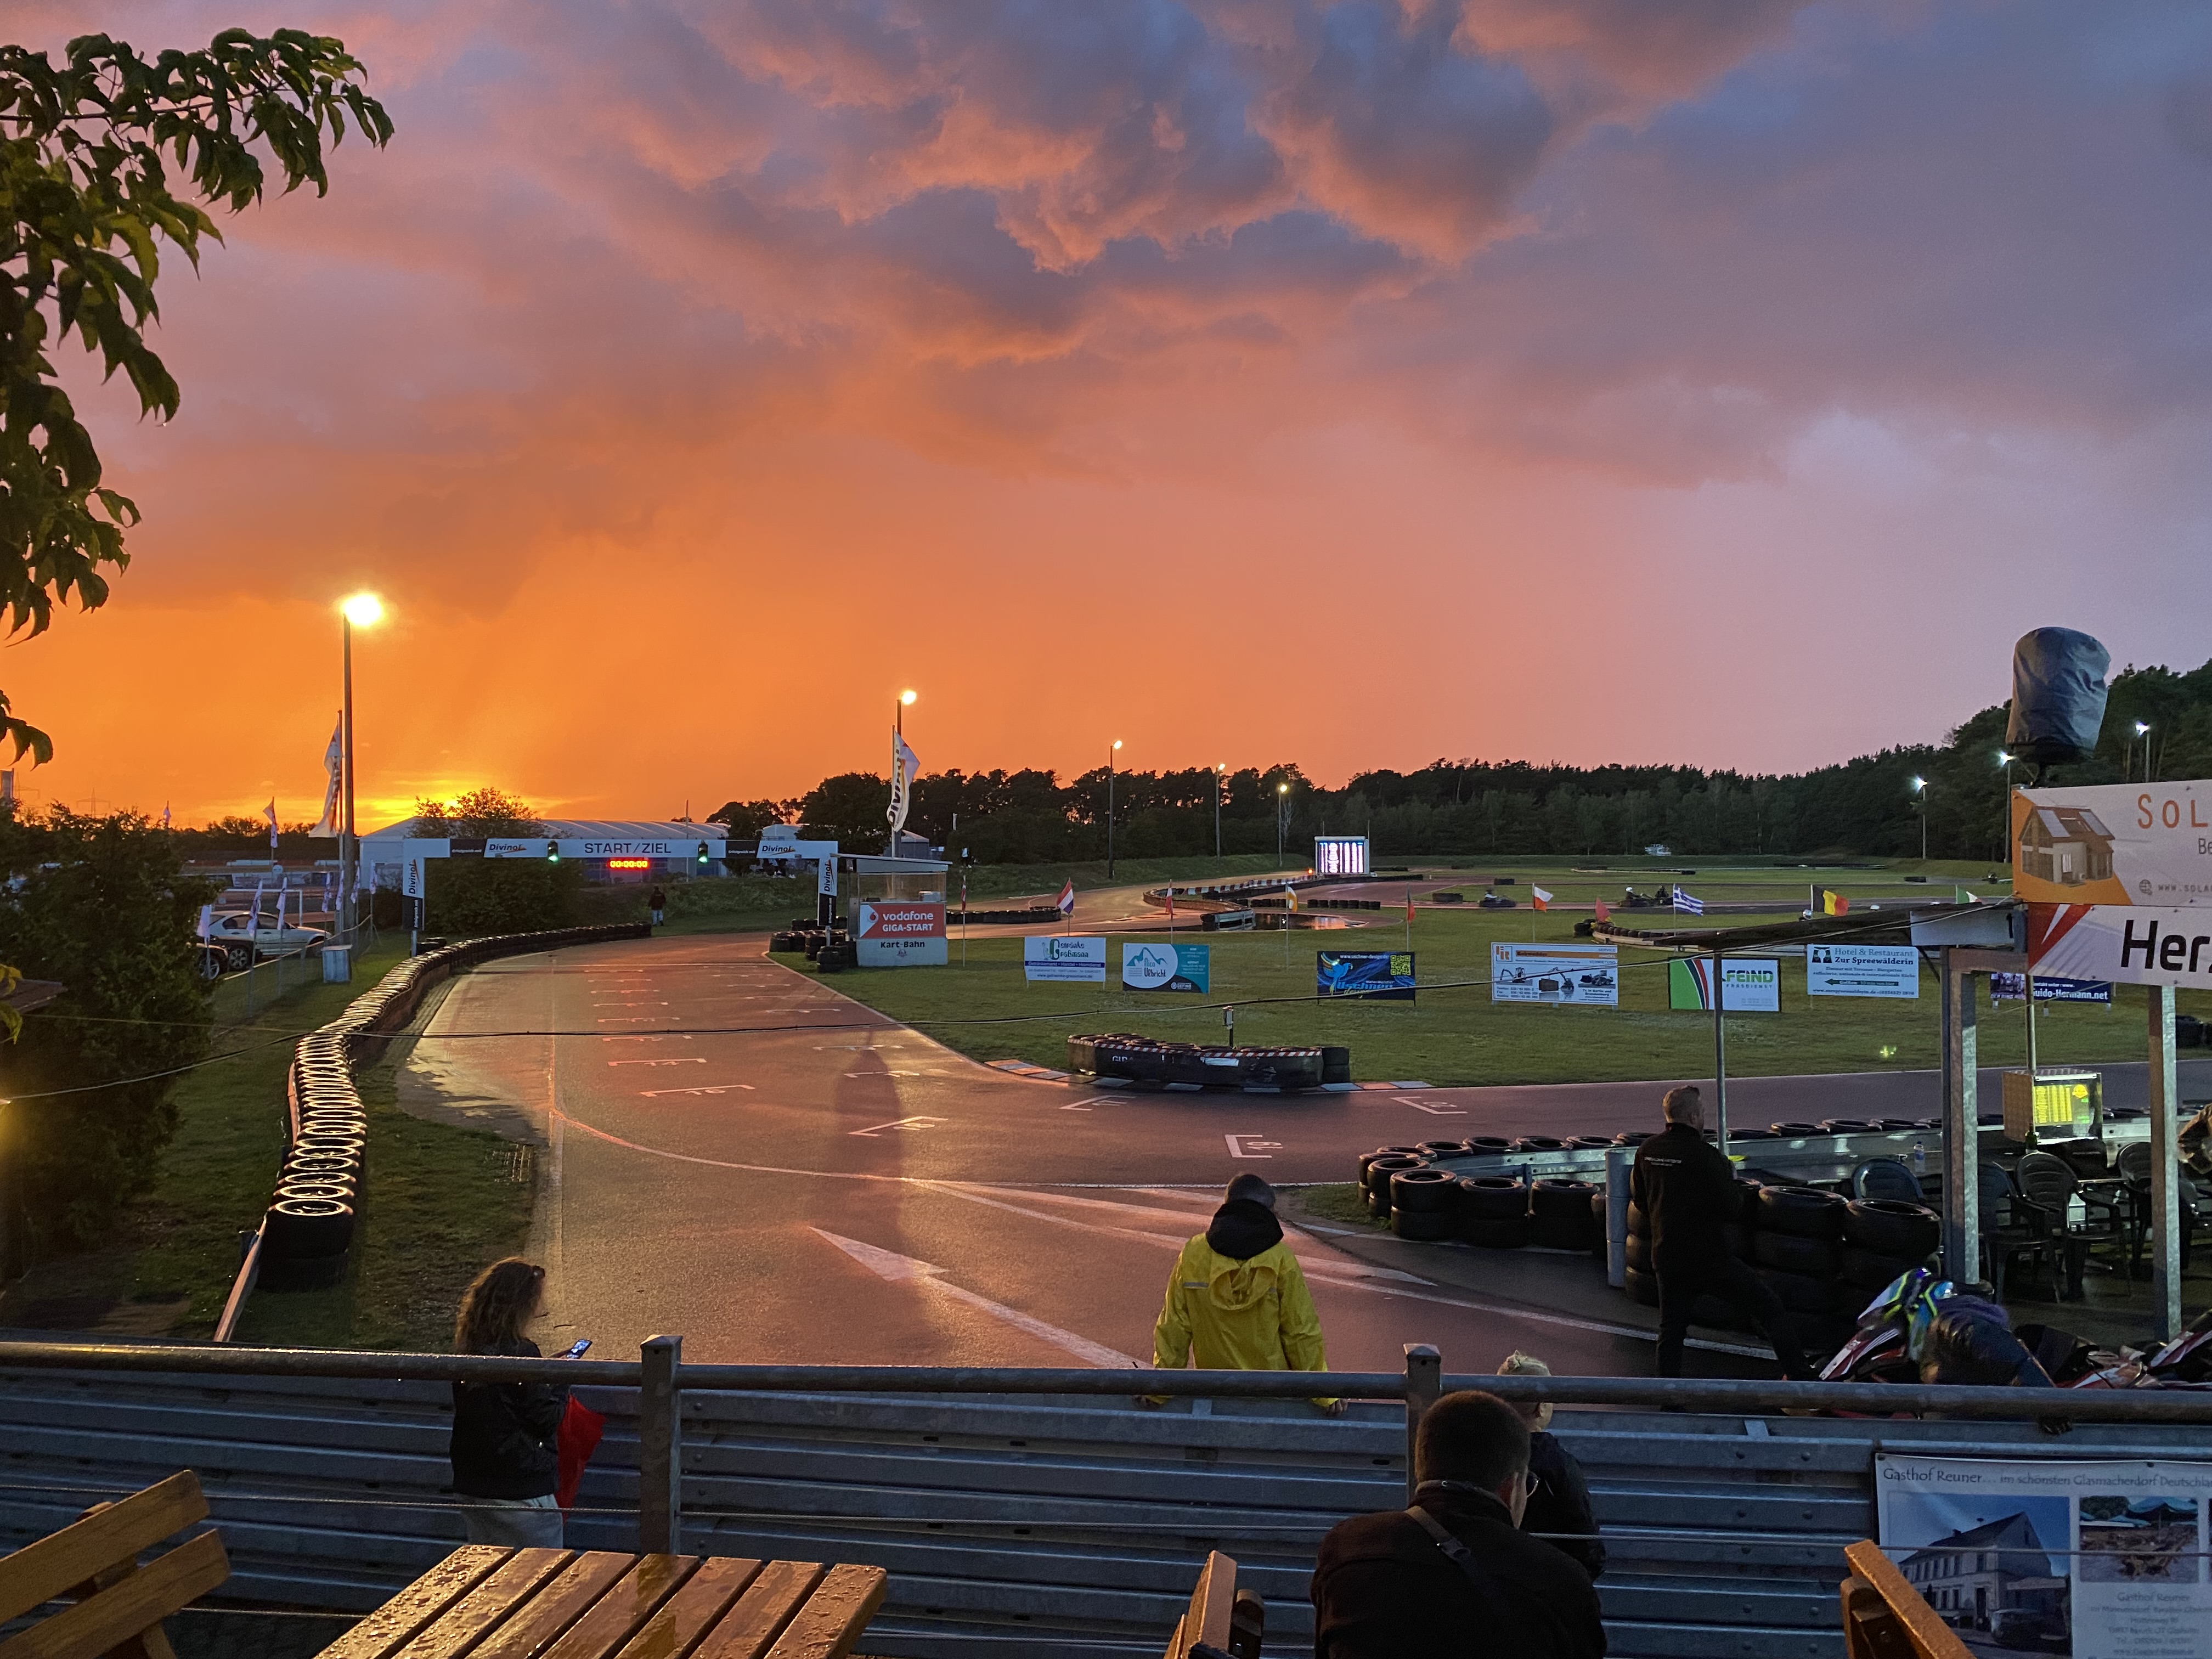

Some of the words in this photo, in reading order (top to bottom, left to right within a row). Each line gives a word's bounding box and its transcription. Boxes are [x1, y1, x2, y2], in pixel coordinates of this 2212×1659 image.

[584, 843, 672, 854] START/ZIEL
[610, 860, 648, 868] 00:00:00
[408, 863, 416, 894] Divinol
[882, 911, 934, 921] vodafone
[882, 923, 934, 932] GIGA-START
[2120, 919, 2212, 973] Her
[1144, 957, 1155, 967] Nico
[1852, 957, 1914, 965] Spreewälderin
[1726, 970, 1774, 983] FEIND
[1246, 1141, 1284, 1150] 19
[1883, 1467, 1936, 1481] Gasthof
[2018, 1472, 2070, 1485] schönsten
[2073, 1474, 2160, 1486] Glasmacherdorf
[2160, 1475, 2212, 1488] Deutschla
